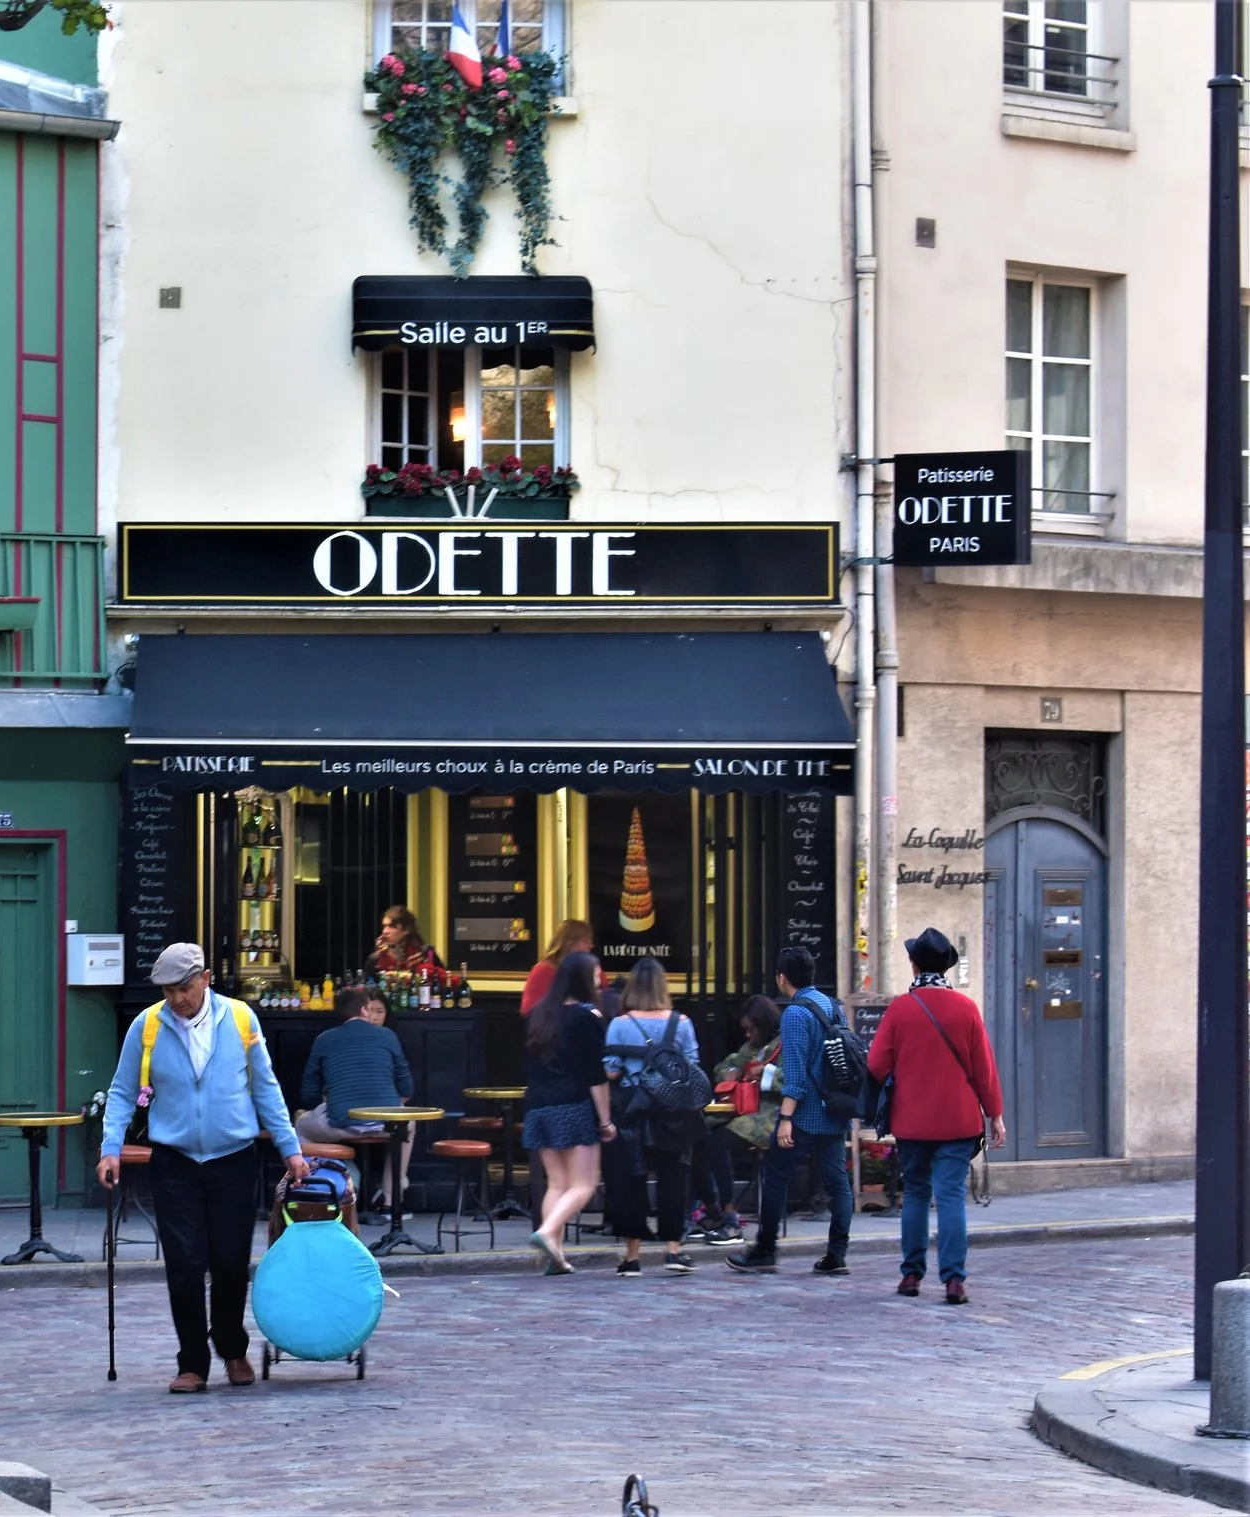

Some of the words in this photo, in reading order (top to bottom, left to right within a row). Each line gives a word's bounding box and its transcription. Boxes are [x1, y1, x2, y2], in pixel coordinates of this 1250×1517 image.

[400, 321, 466, 344] Salle
[474, 326, 507, 344] au
[917, 466, 995, 484] Patisserie
[898, 494, 1013, 525] ODETTE
[929, 536, 981, 553] PARIS
[313, 530, 636, 596] ODETTE
[162, 756, 256, 774] PATISSERIE
[322, 759, 351, 773] Les
[355, 758, 432, 773] meilleurs
[435, 759, 488, 773] choux
[494, 758, 505, 774] à
[509, 759, 525, 774] la
[528, 759, 583, 774] crème
[586, 759, 609, 774] de
[613, 759, 655, 774] Paris
[692, 758, 759, 777] SALON
[762, 759, 788, 776] DE
[928, 827, 985, 854] Coquille
[933, 864, 992, 890] Jacques
